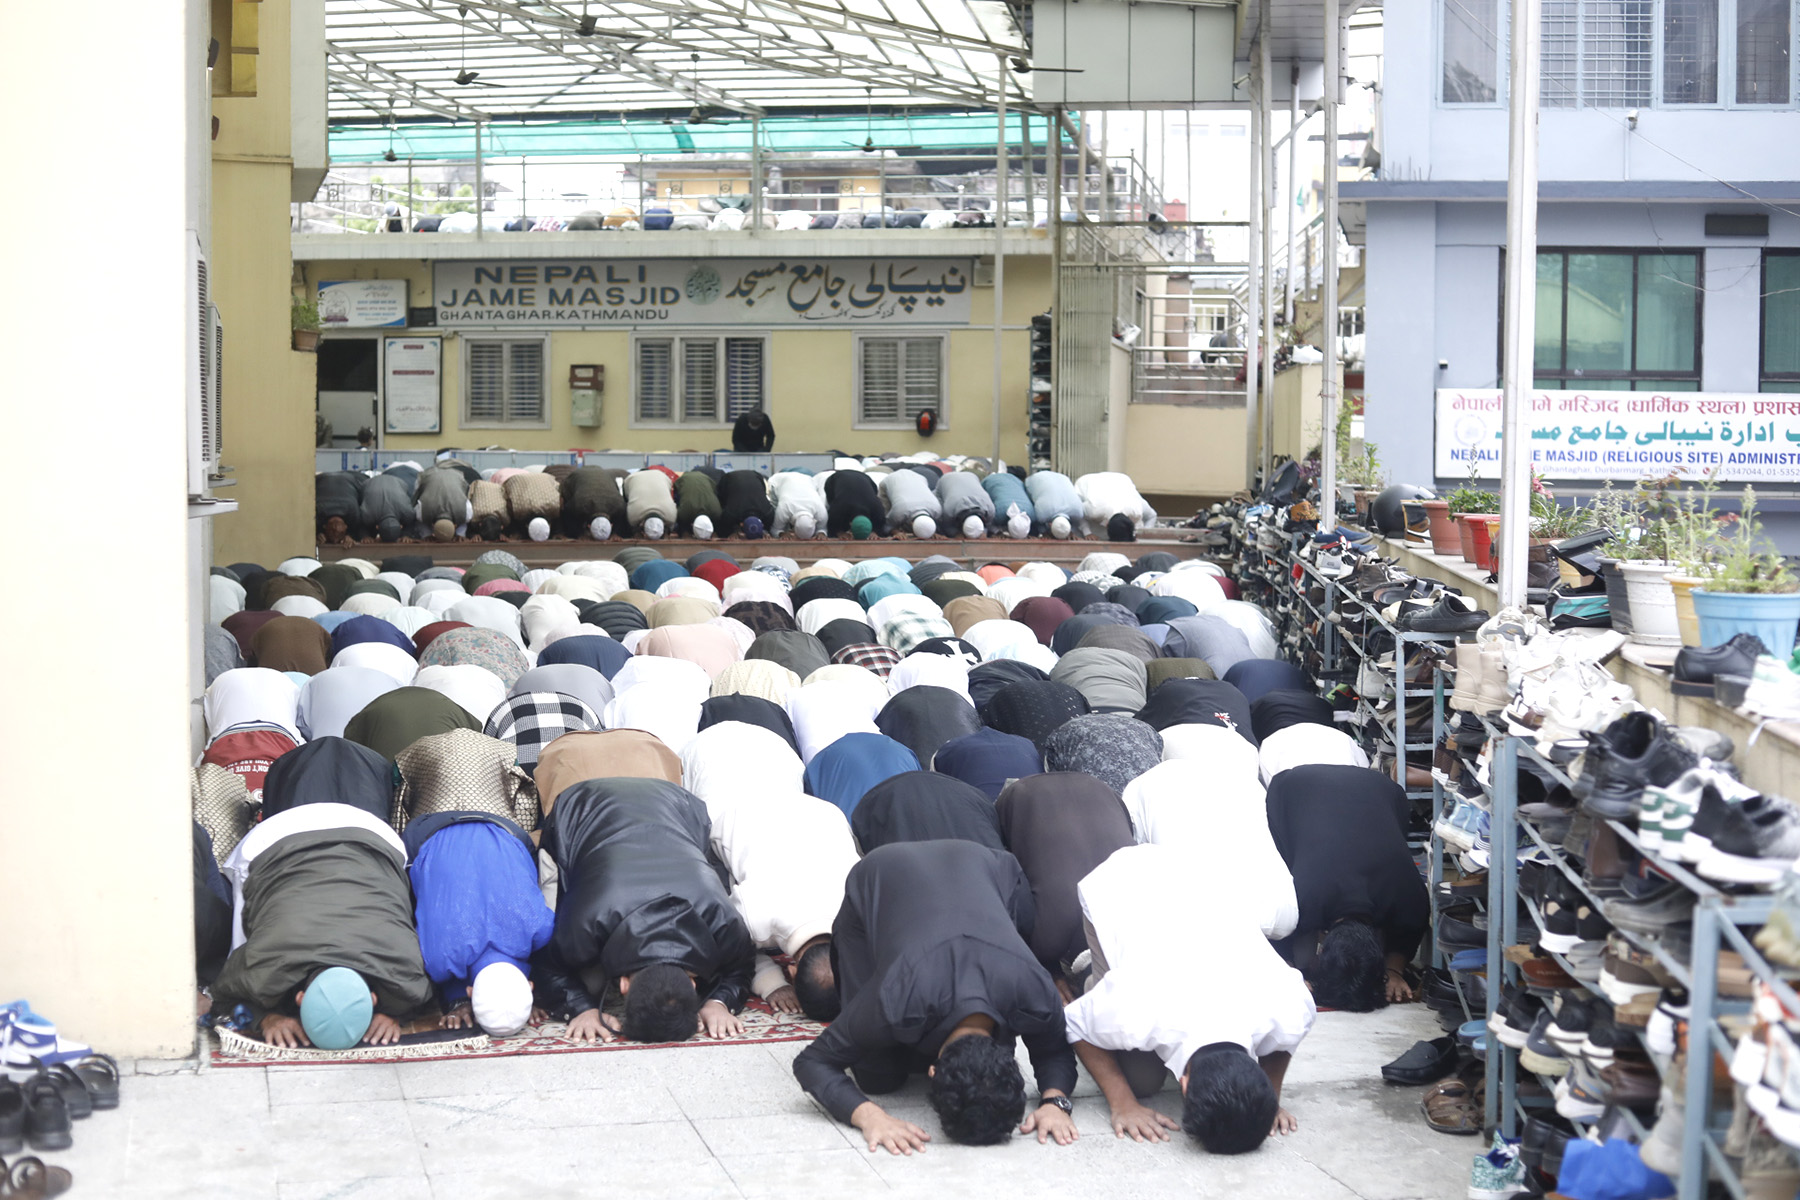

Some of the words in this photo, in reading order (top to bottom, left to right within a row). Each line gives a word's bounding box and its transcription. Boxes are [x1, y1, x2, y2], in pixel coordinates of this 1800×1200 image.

[474, 264, 647, 285] NEPALI
[441, 287, 536, 308] JAME
[549, 286, 681, 307] MASJID
[1546, 450, 1598, 462] MASJID
[1602, 451, 1683, 465] (RELIGIOUS
[1687, 452, 1724, 465] SITE)
